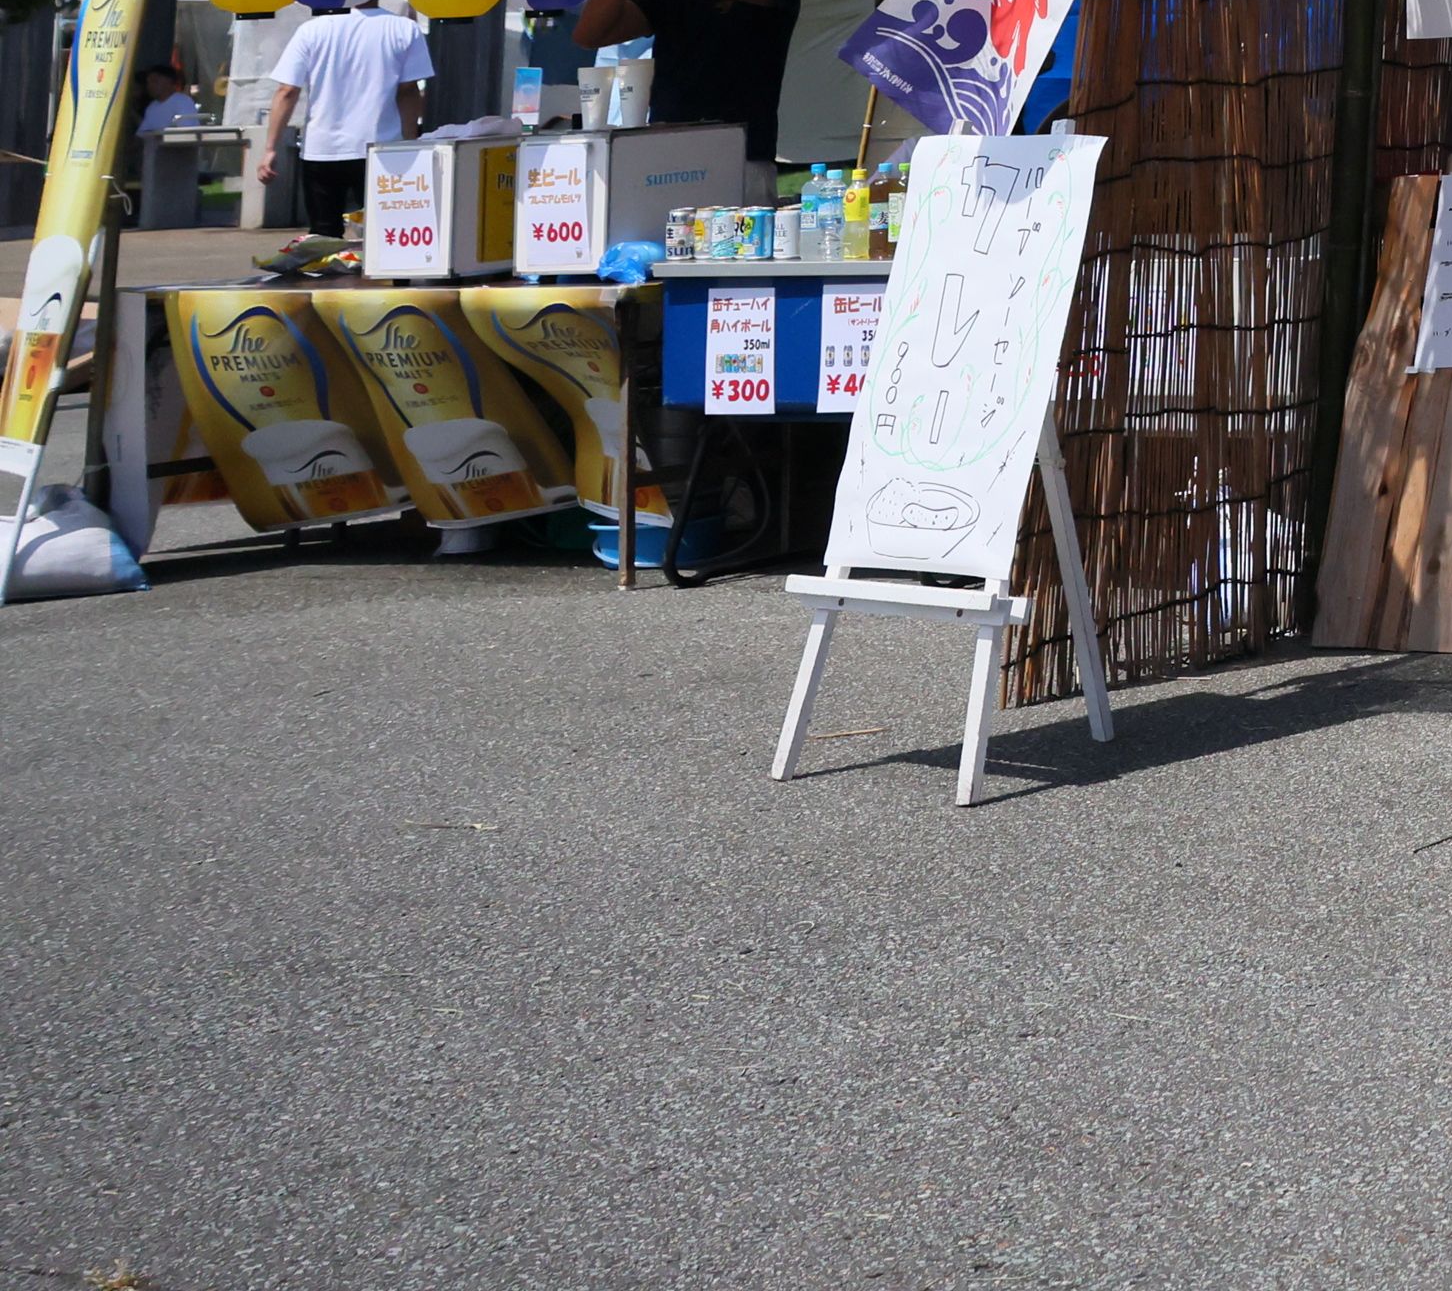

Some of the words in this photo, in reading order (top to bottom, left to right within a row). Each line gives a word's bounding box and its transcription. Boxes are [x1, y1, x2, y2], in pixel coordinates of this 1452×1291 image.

[85, 30, 128, 49] PREMIUM
[376, 174, 430, 194] 生ビール
[528, 167, 582, 188] 生ビール
[385, 225, 434, 248] ¥600
[532, 220, 584, 243] ¥600
[712, 297, 771, 313] 缶チューハイ
[929, 155, 1021, 445] カレー
[980, 166, 1045, 429] ハーブソーセージ
[710, 318, 772, 334] 角ハイボール
[862, 329, 876, 342] 35
[743, 338, 771, 351] 350ml
[211, 350, 300, 372] PREMIUM
[365, 349, 452, 368] PREMIUM
[711, 379, 770, 402] ¥300
[874, 341, 909, 436] 900円
